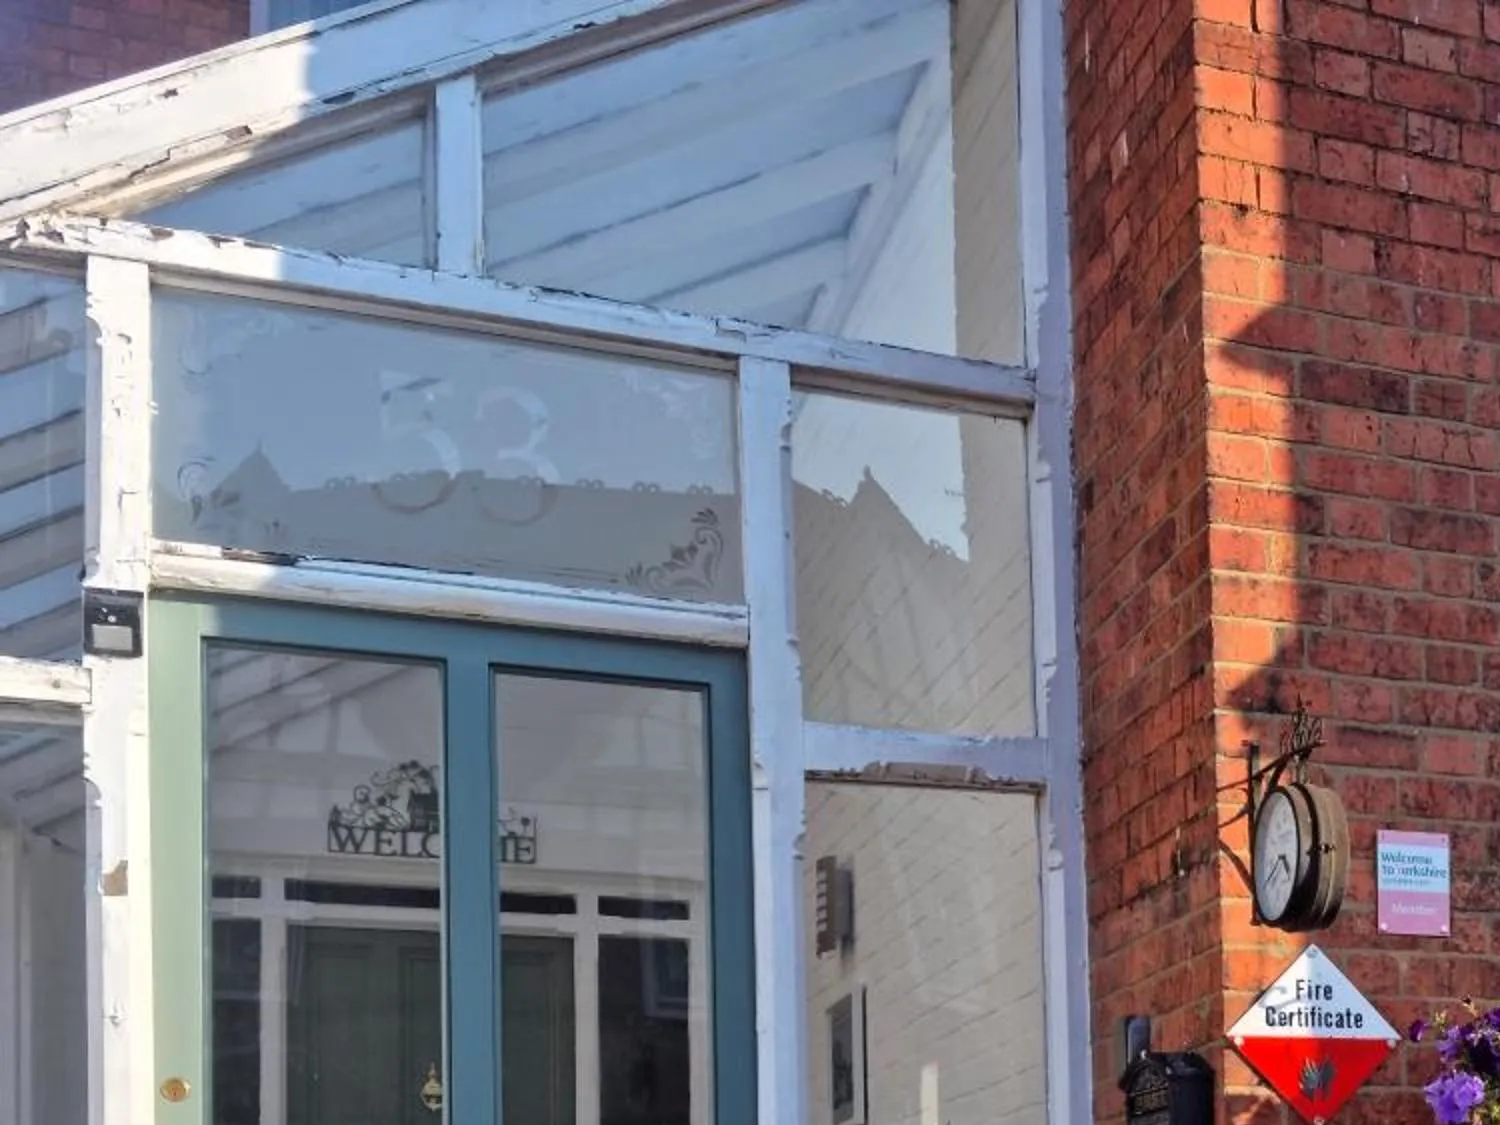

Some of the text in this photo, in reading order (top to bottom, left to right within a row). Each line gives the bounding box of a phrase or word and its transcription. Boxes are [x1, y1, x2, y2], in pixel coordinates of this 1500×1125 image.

[371, 369, 560, 527] 53
[330, 825, 537, 864] WELCE
[1381, 851, 1433, 864] Welcome
[1295, 979, 1333, 1001] Fire
[1265, 1005, 1364, 1029] Certificate
